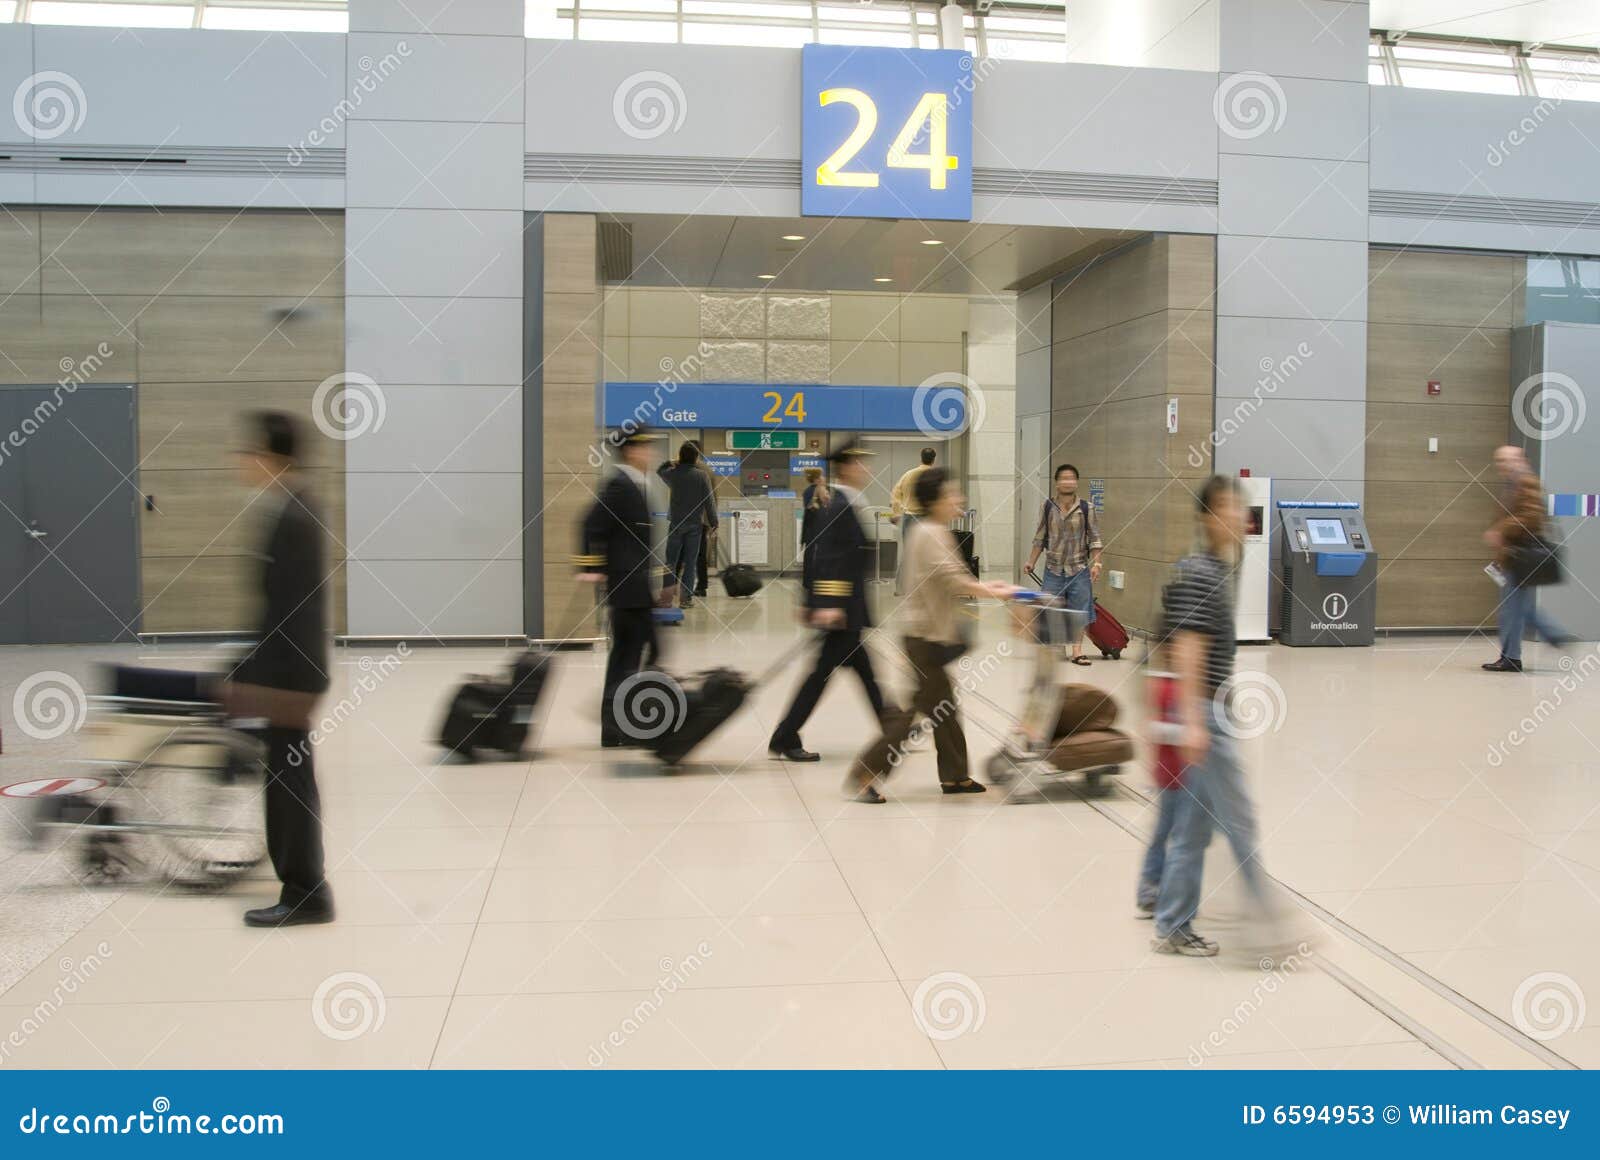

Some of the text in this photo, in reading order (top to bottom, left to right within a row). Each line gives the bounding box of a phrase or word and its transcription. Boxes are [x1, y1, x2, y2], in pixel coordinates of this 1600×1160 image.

[816, 87, 959, 190] 24
[662, 391, 807, 423] Gate 24
[1311, 621, 1359, 630] information
